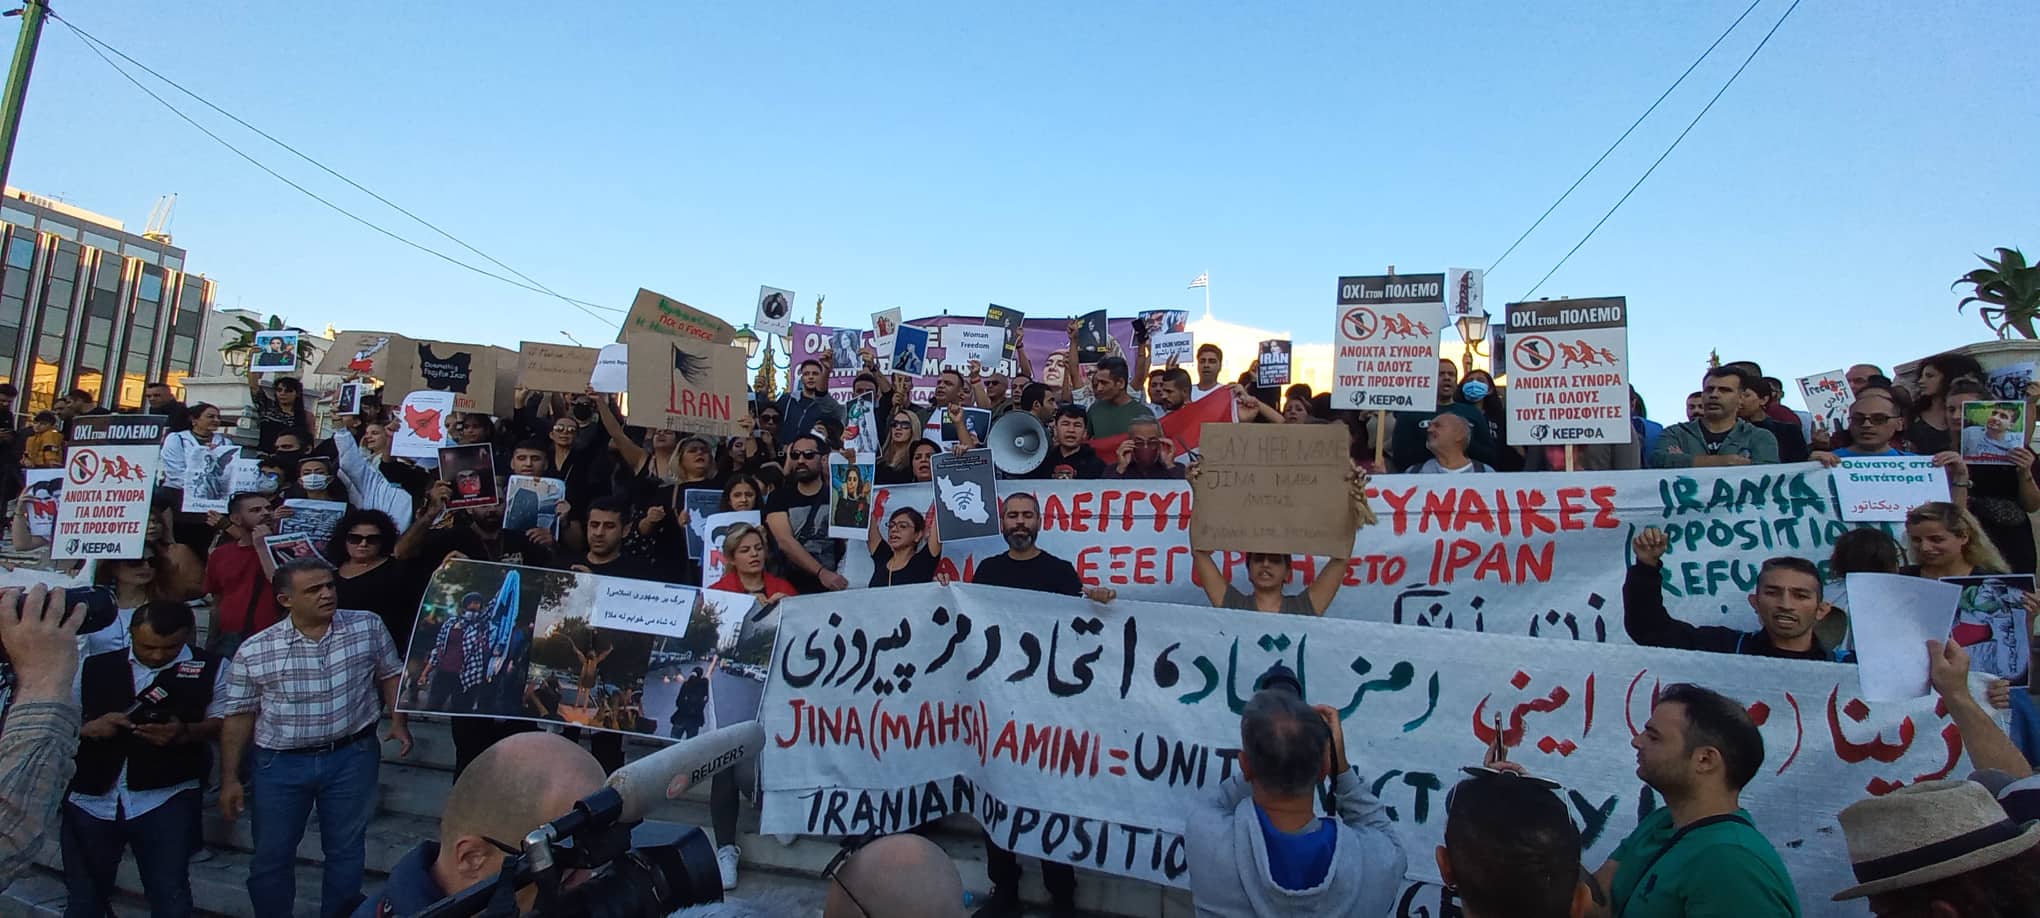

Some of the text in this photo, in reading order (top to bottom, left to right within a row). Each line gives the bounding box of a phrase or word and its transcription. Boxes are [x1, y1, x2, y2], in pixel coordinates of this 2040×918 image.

[1343, 284, 1365, 299] ΟΧΙ
[1385, 282, 1439, 298] ΠΟΛΕΜΟ
[1511, 311, 1537, 327] ΟΧΙ
[1560, 306, 1621, 324] ΠΟΛΕΜΟ
[963, 331, 989, 339] Woman
[960, 341, 990, 350] Freedom
[1340, 345, 1433, 358] ΑΝΟΙΧΤΑ ΣΥΝΟΡΑ
[968, 351, 981, 359] Life
[1260, 352, 1289, 365] IRAN
[1357, 360, 1413, 373] ΓΙΑ ΟΛΟΥΣ
[1339, 375, 1431, 388] ΤΟΥΣ ΠΡΟΣΦΥΓΕΣ
[1514, 373, 1622, 390] ΑΝΟΙΧΤΑ ΣΥΝΟΡΑ
[665, 382, 731, 421] IRAN
[1368, 394, 1413, 407] ΚΕΕΡΦΑ
[1535, 390, 1600, 405] ΓΙΑ ΟΛΟΥΣ
[1515, 405, 1622, 421] ΤΟΥΣ ΠΡΟΣΦΥΓΕΣ
[74, 425, 91, 440] ΟΧΙ
[108, 425, 158, 440] ΠΟΛΕΜΟ
[1552, 427, 1605, 440] ΚΕΕΡΦΑ
[1841, 459, 1905, 472] Θάνατος
[1850, 471, 1925, 484] δικτάτορα
[64, 489, 145, 503] ΑΝΟΙΧΤΑ ΣΥΝΟΡΑ
[75, 506, 126, 519] ΓΙΑ ΟΛΟΥΣ
[60, 521, 141, 535] ΤΟΥΣ ΠΡΟΣΦΥΓΕΣ
[82, 542, 121, 554] ΚΕΕΡΦΑ
[1428, 539, 1556, 587] ΙΡΑΝ
[775, 698, 865, 750] JINA
[992, 719, 1101, 778] AMINI
[691, 744, 745, 784] REUTERS
[798, 775, 976, 834] IRANIAN
